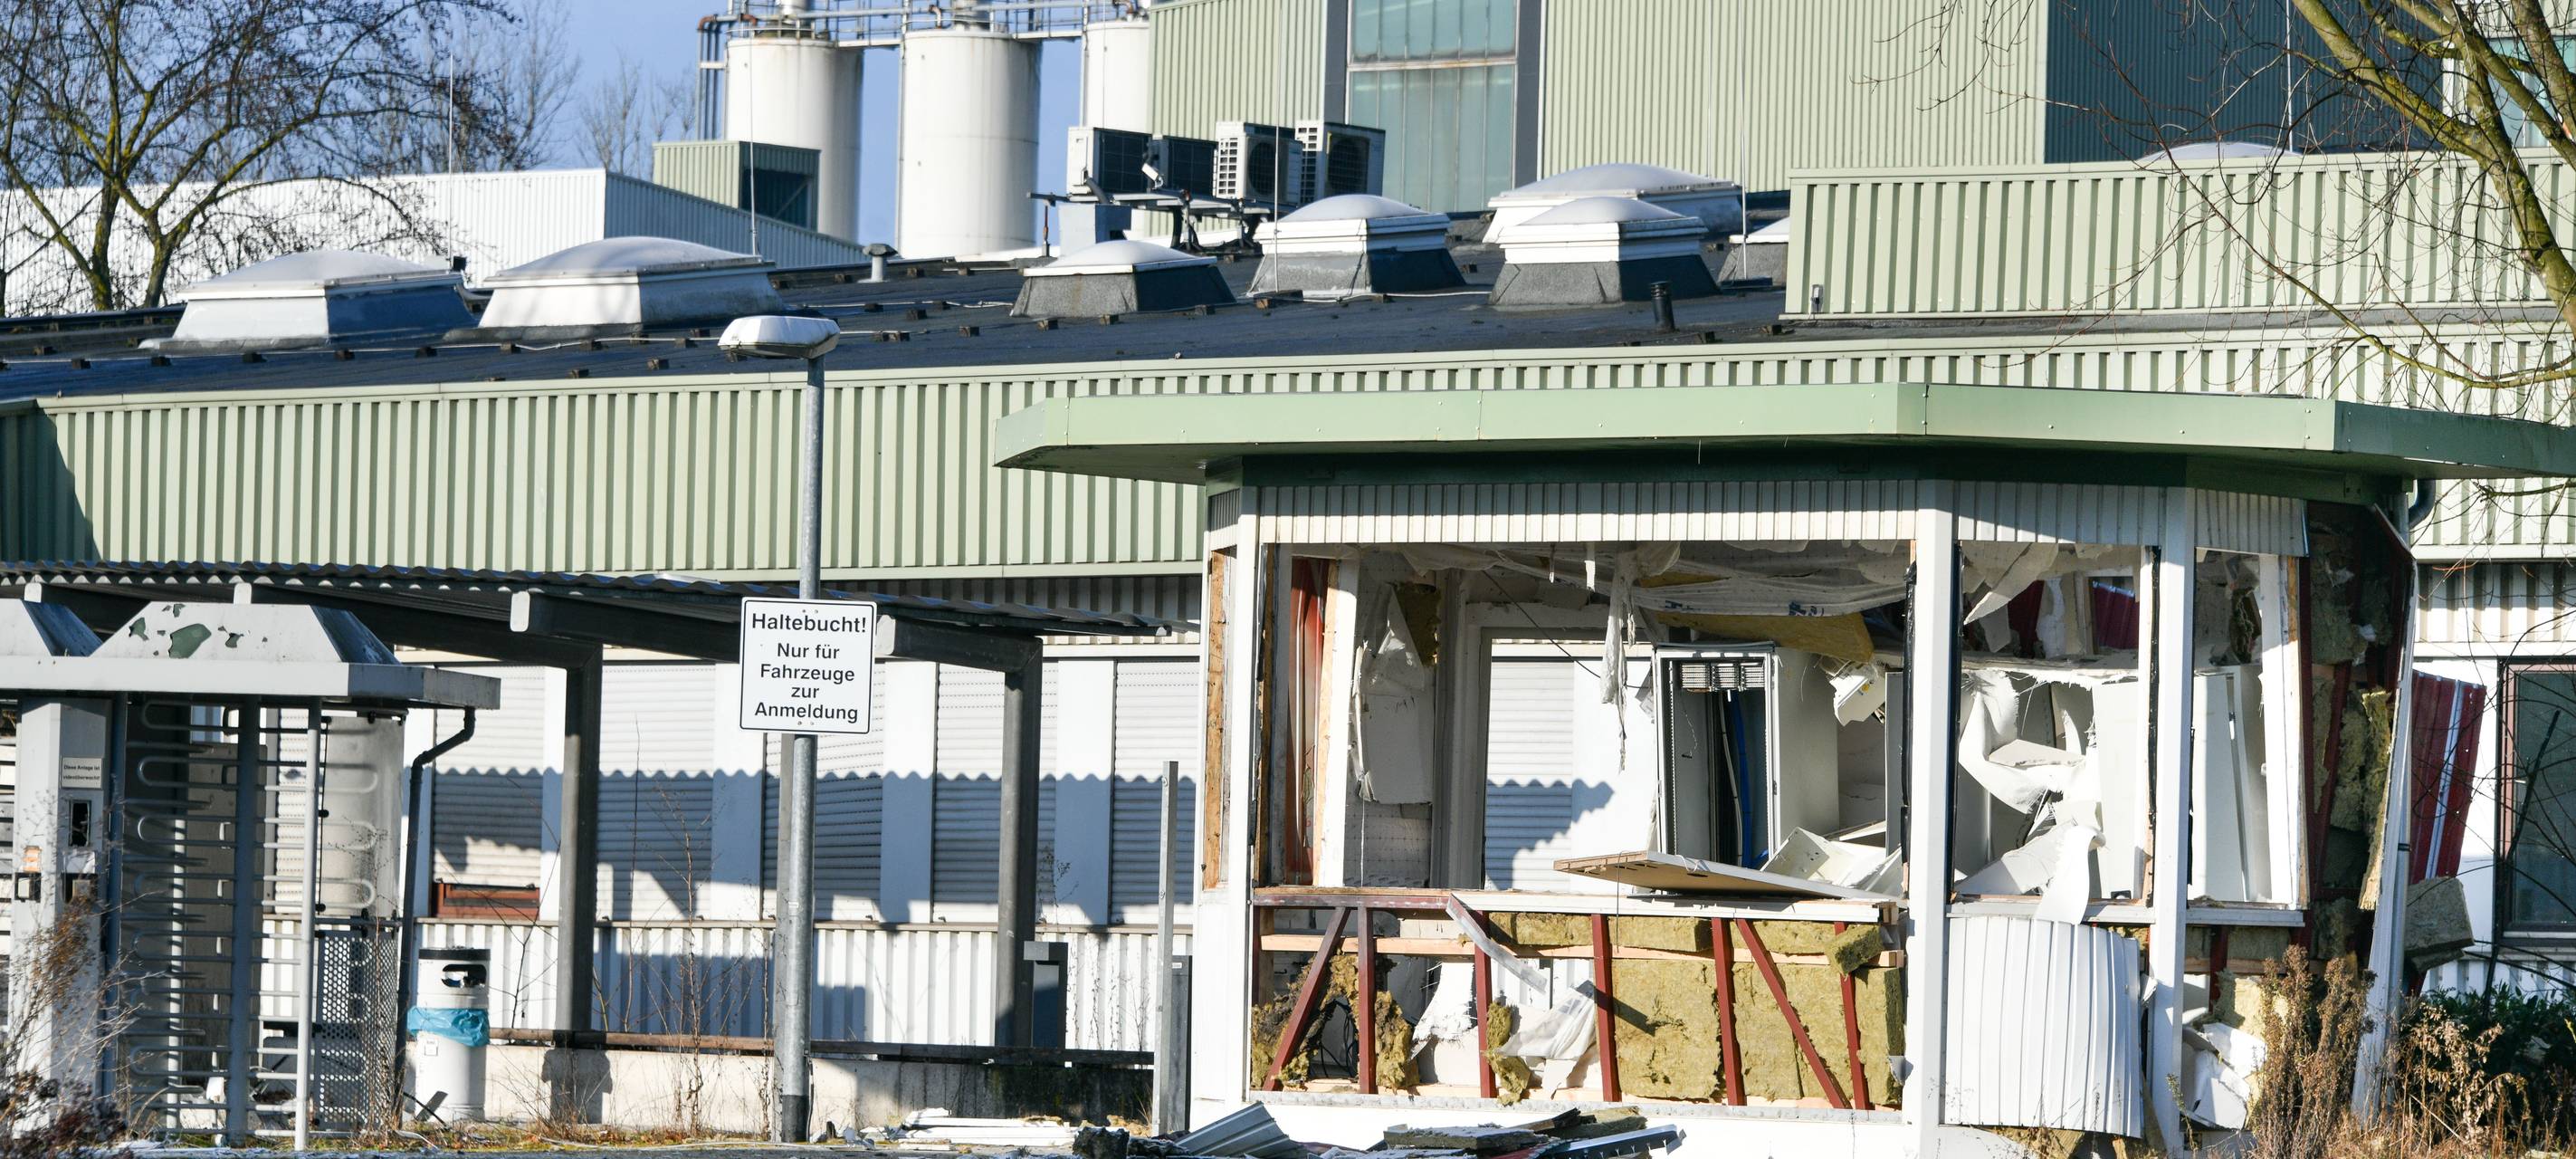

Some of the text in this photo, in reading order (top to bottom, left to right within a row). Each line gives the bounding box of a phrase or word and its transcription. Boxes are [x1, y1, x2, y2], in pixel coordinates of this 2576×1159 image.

[752, 613, 866, 633] Haltebucht!
[778, 643, 840, 659] Nur für
[760, 663, 855, 685] Fahrzeuge
[791, 686, 820, 698] zur
[755, 702, 858, 723] Anmeldung
